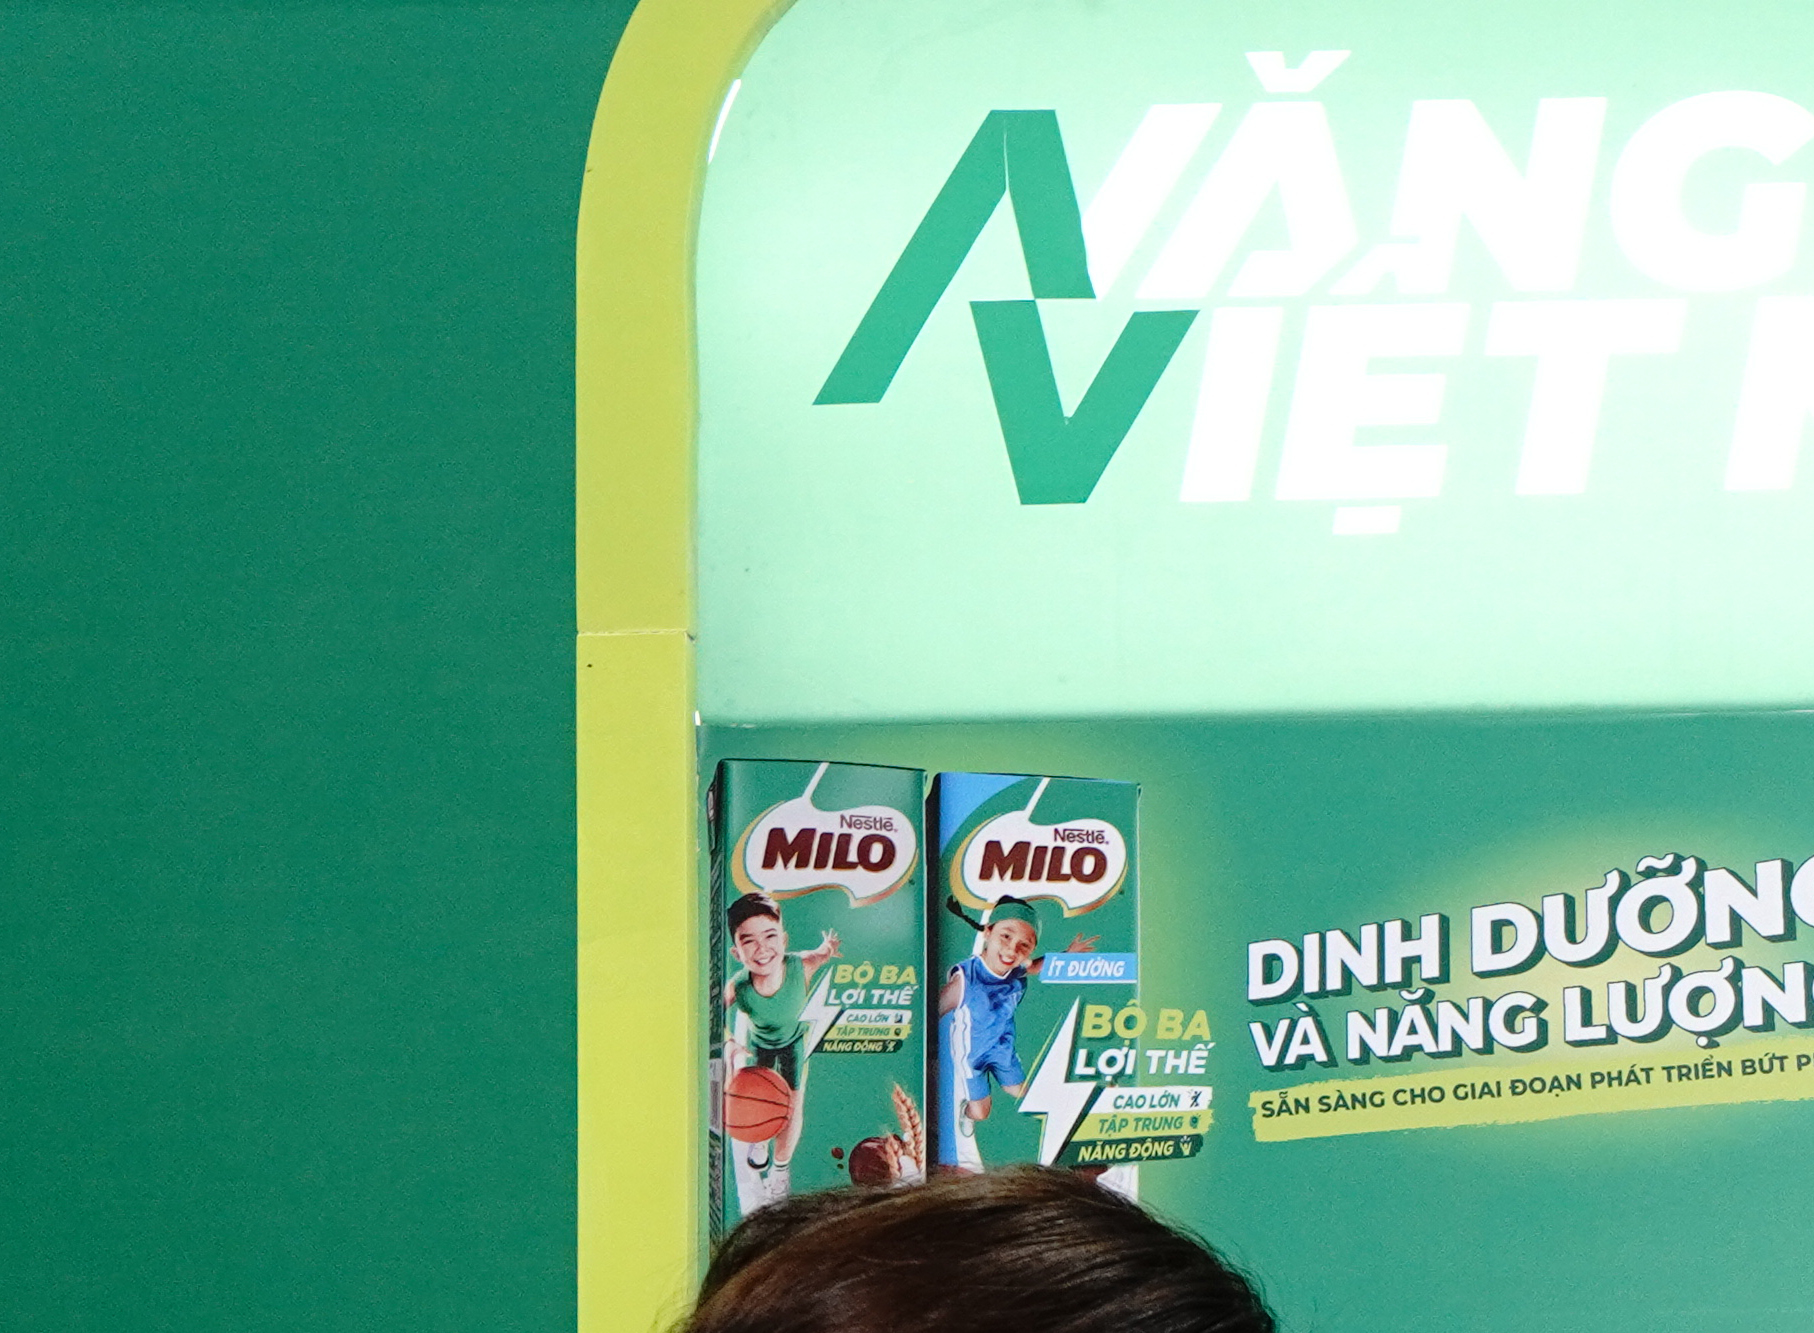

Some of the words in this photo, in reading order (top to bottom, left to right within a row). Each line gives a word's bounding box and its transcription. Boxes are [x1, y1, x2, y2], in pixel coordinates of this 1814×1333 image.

[761, 827, 897, 873] MILO
[979, 839, 1107, 883] MILO
[834, 961, 879, 985] BỘ
[885, 964, 918, 985] BA
[1048, 958, 1066, 977] ÍT
[1068, 958, 1125, 978] ĐƯỜNG
[1246, 913, 1442, 1001] DINH
[871, 981, 919, 1006] THẾ
[1083, 1003, 1148, 1043] BỘ
[1156, 1009, 1211, 1041] BA
[1249, 1003, 1330, 1067] VÀ
[1346, 989, 1541, 1060] NĂNG
[1074, 1041, 1134, 1077] LỢI
[1147, 1041, 1215, 1075] THẾ
[1113, 1093, 1145, 1110] CAO
[1148, 1089, 1180, 1109] LỚN
[1261, 1092, 1311, 1119] SẴN
[1318, 1085, 1387, 1115] SÀNG
[1392, 1084, 1447, 1107] CHO
[1455, 1080, 1502, 1101] GIAI
[1509, 1072, 1583, 1100] ĐOẠN
[1590, 1064, 1656, 1091] PHÁT
[1662, 1055, 1732, 1085] TRIỂN
[1740, 1053, 1791, 1076] BỨT
[1099, 1112, 1131, 1134] TẬP
[1134, 1114, 1184, 1132] TRUNG
[1078, 1140, 1126, 1161] NĂNG
[1128, 1139, 1175, 1163] ĐỘNG
